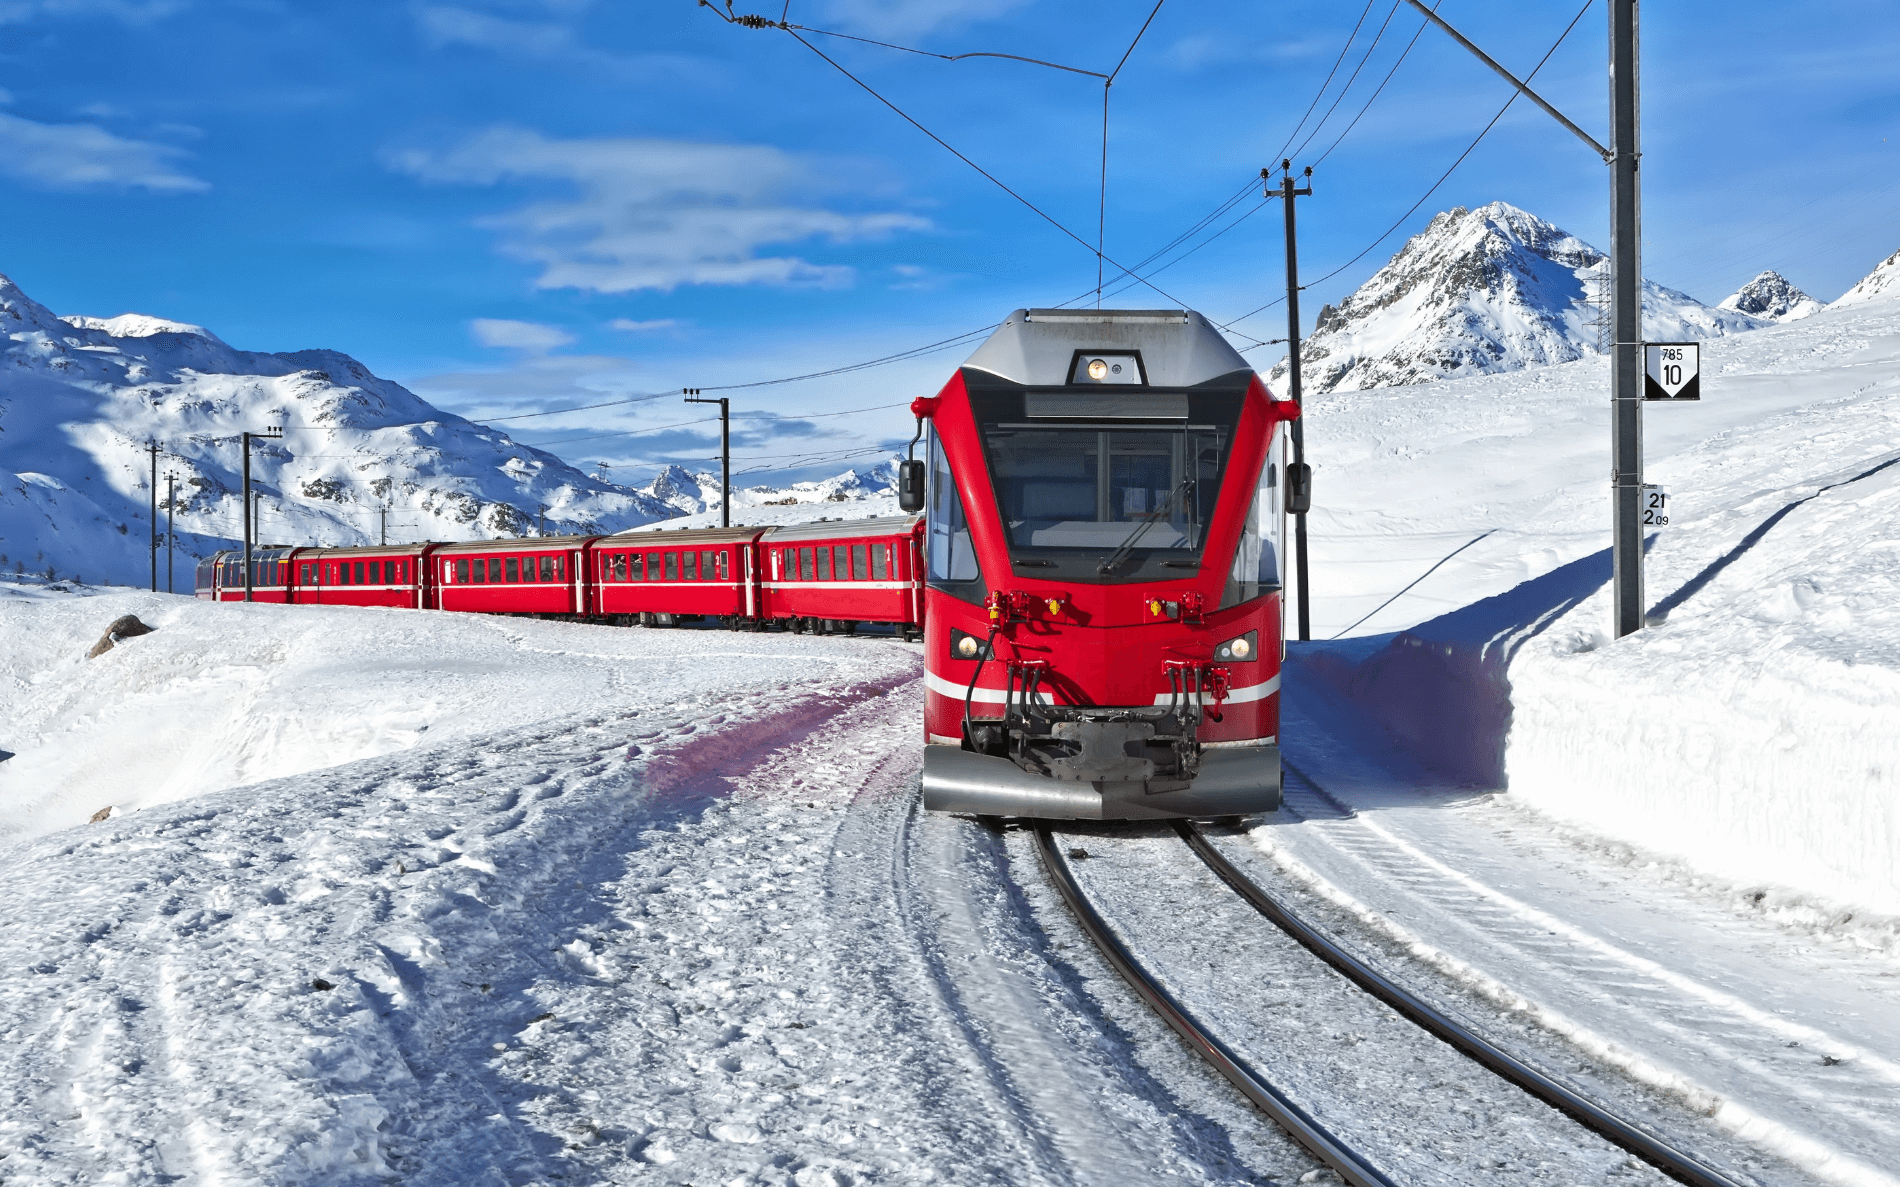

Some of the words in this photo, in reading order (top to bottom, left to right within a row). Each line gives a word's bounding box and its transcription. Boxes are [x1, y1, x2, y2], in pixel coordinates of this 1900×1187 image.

[1662, 349, 1683, 361] 785
[1664, 365, 1682, 386] 10
[1649, 493, 1665, 509] 21
